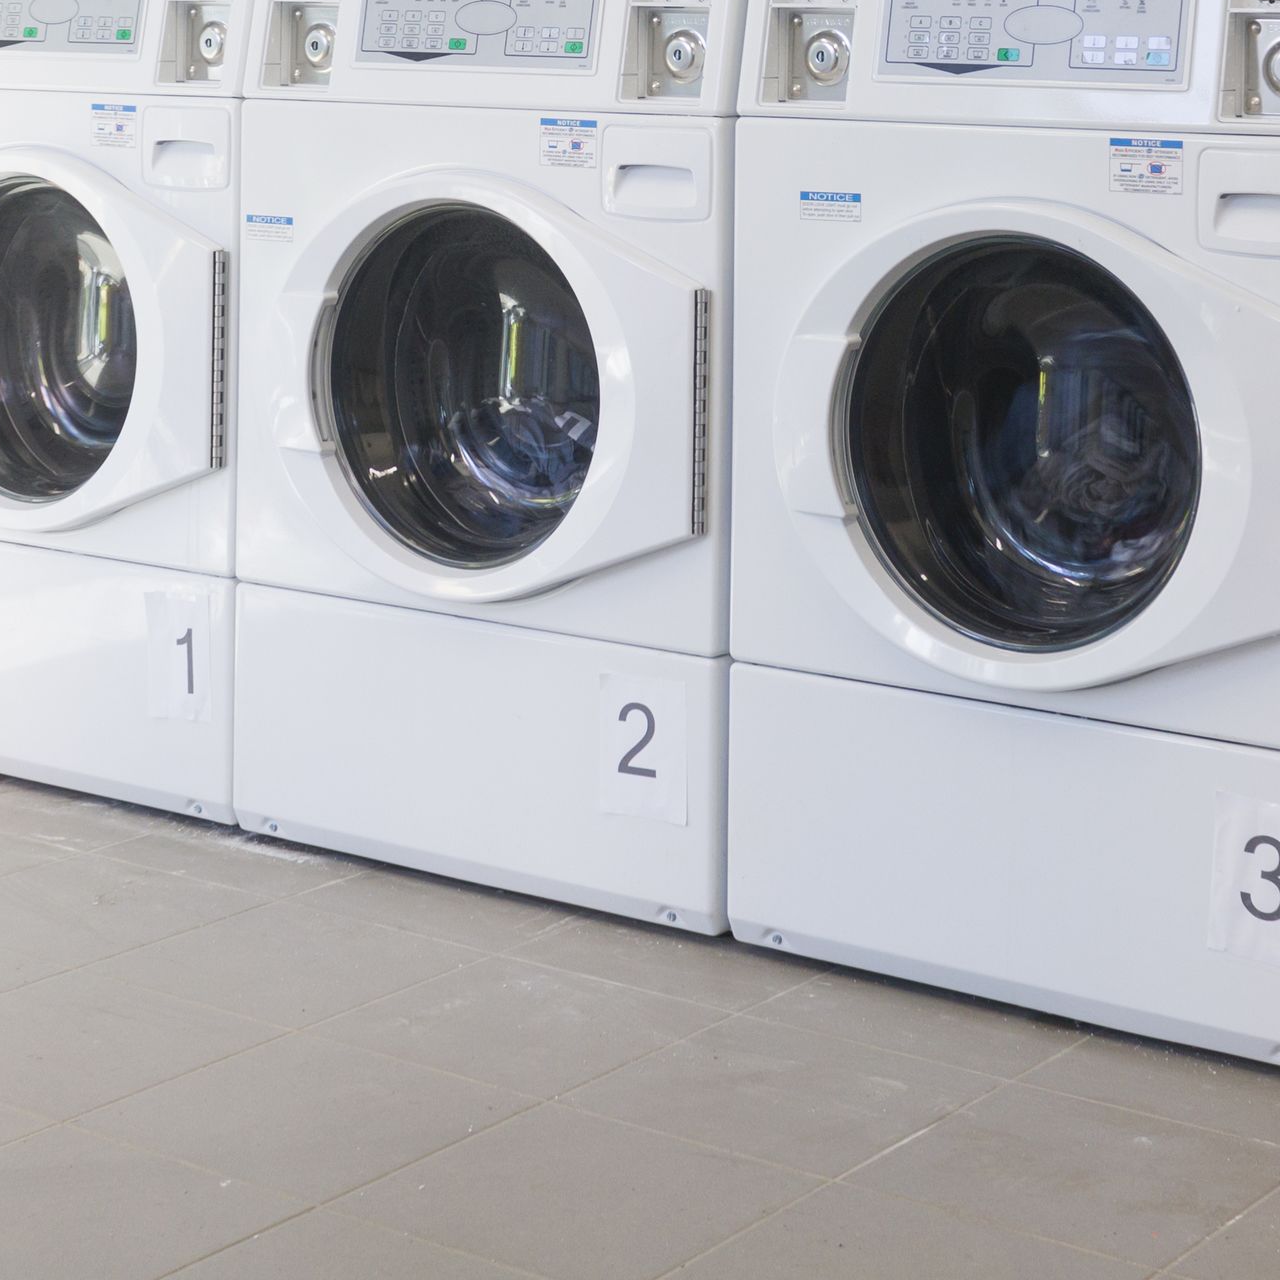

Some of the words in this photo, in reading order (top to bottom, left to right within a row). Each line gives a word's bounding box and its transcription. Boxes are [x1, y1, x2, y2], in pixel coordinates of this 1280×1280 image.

[1131, 139, 1162, 147] NOTICE
[808, 192, 853, 202] NOTICE
[252, 216, 287, 224] NOTICE
[177, 628, 193, 694] 1
[618, 703, 656, 777] 2
